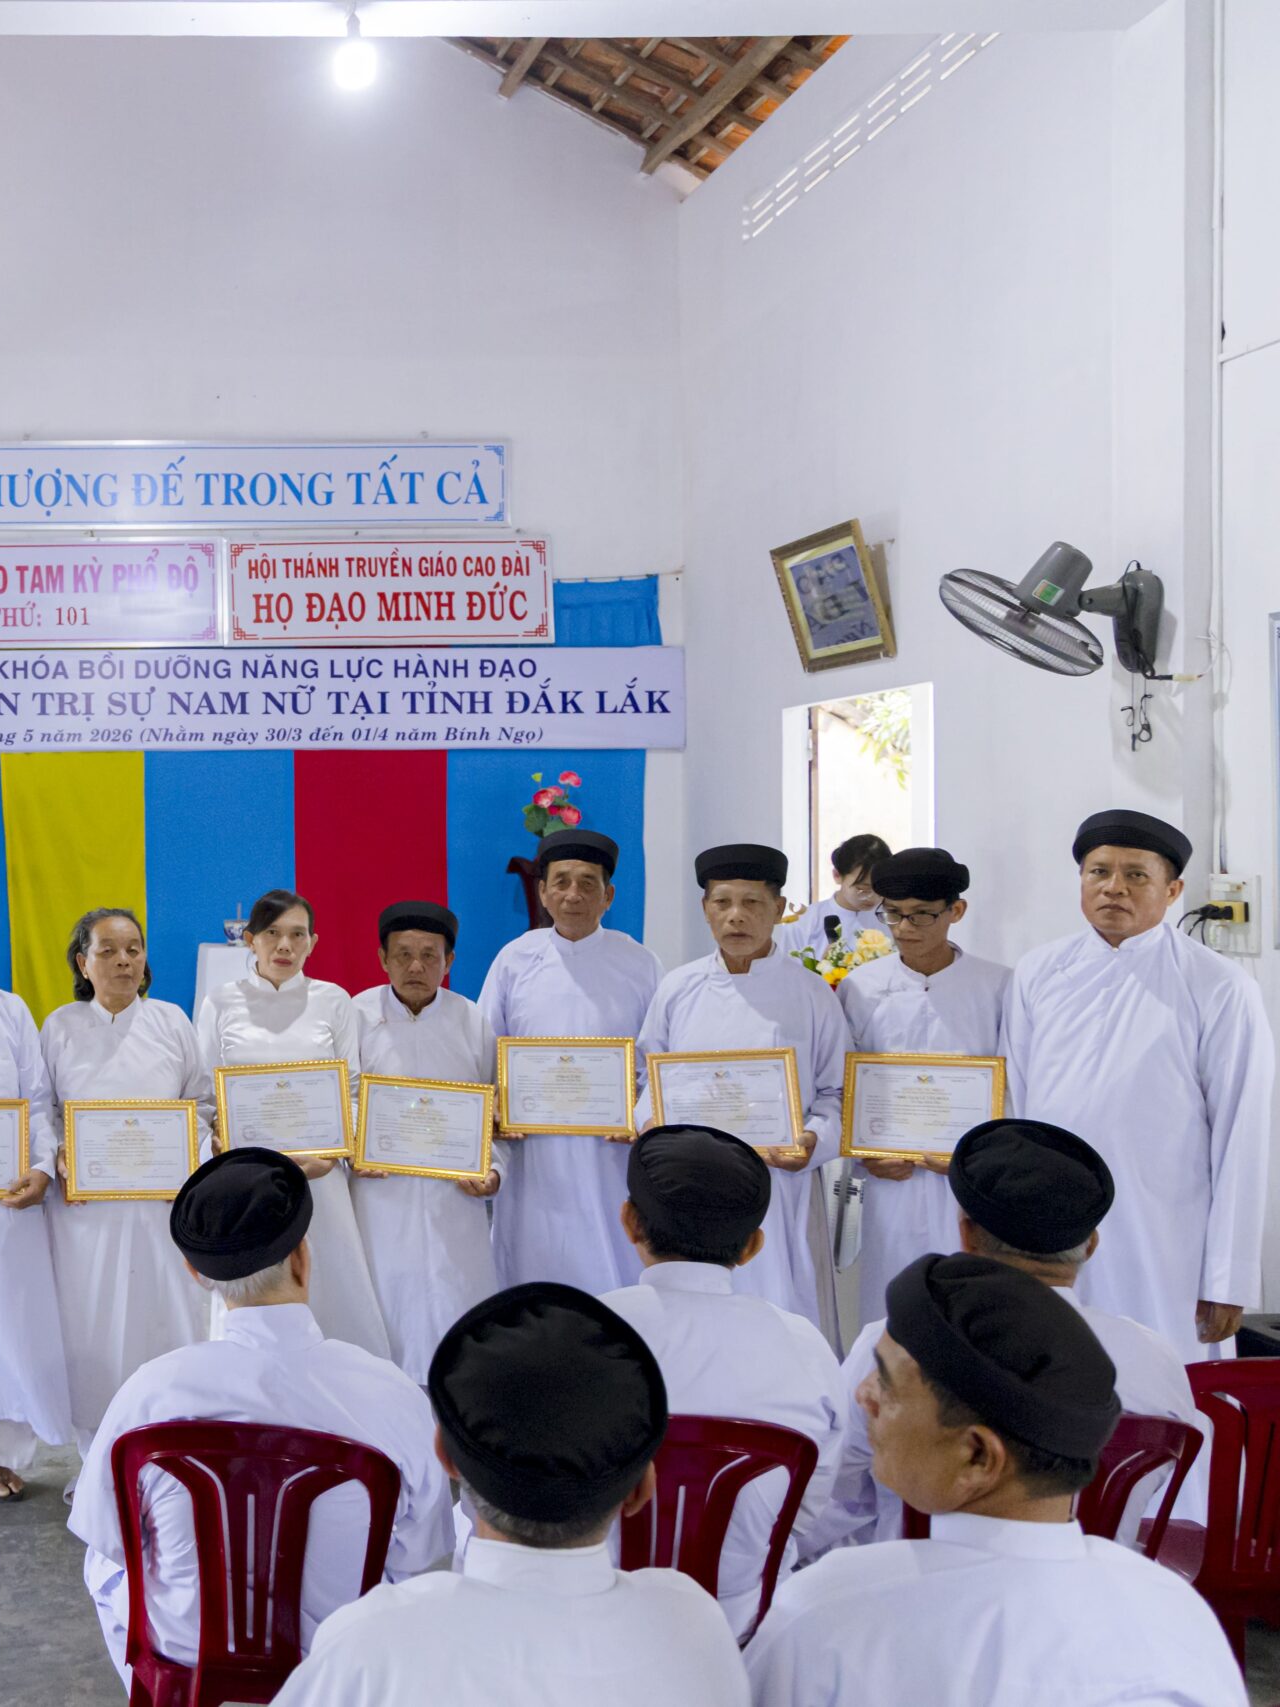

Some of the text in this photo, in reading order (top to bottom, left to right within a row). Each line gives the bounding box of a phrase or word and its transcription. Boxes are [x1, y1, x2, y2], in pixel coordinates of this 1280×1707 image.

[132, 458, 185, 506] ĐẾ
[195, 472, 335, 507] TRONG
[346, 454, 425, 505] TẤT
[436, 459, 489, 505] CẢ
[15, 564, 64, 594] TAM
[73, 556, 103, 593] KỲ
[112, 549, 160, 593] PHỔ
[247, 547, 530, 584] HỘI THÁNH TRUYỀN GIÁO CAO ĐÀI
[55, 606, 91, 626] 101
[252, 581, 528, 631] HỌ ĐẠO MINH ĐỨC
[79, 652, 124, 680] BỒI
[134, 654, 231, 680] DƯỠNG
[242, 654, 319, 679] NĂNG
[329, 656, 384, 683] LỰC
[393, 653, 469, 679] HÀNH
[478, 658, 537, 682] ĐẠO
[31, 692, 95, 722] TRỊ
[107, 686, 156, 722] SỰ
[167, 691, 250, 716] NAM
[262, 684, 316, 715] NỮ
[327, 691, 390, 721] TẠI
[401, 680, 493, 715] TỈNH
[504, 677, 585, 714] ĐẮK
[596, 677, 671, 714] LẮK
[23, 729, 34, 743] 5
[40, 732, 82, 743] năm
[89, 728, 133, 743] 2026
[139, 727, 204, 743] (Nhằm
[212, 731, 259, 745] ngày
[265, 727, 303, 742] 30/3
[308, 725, 344, 742] đến
[351, 727, 389, 742] 01/4
[395, 728, 437, 742] năm
[444, 726, 490, 741] Bính
[497, 726, 544, 744] Ngọ)
